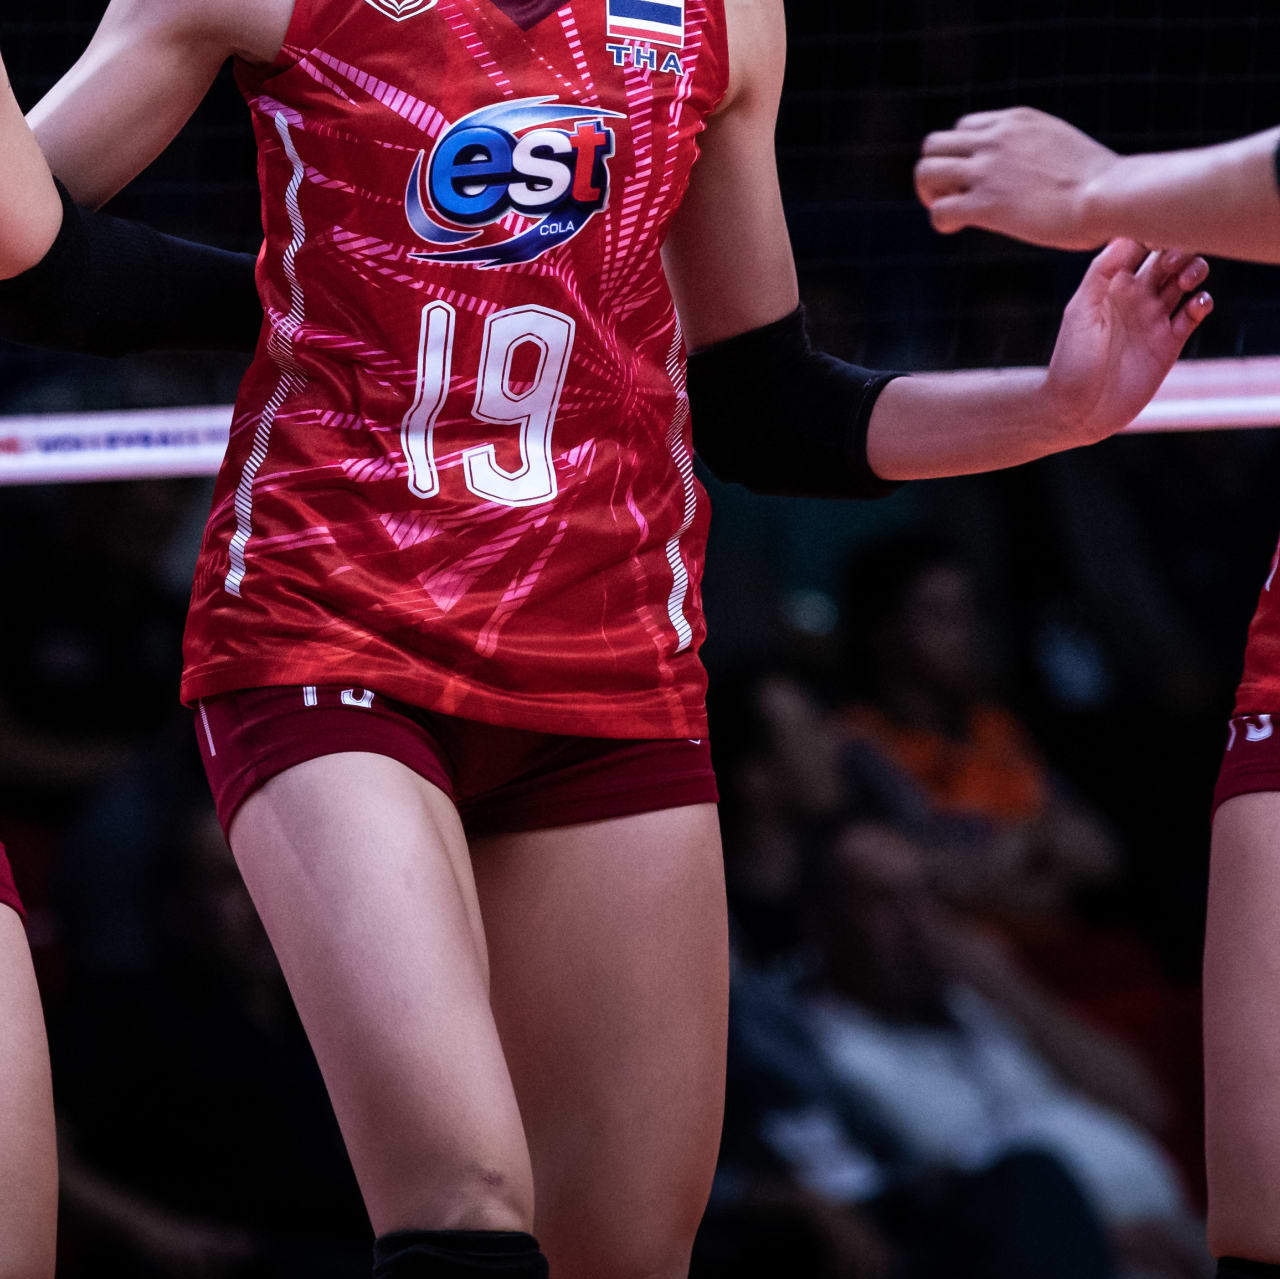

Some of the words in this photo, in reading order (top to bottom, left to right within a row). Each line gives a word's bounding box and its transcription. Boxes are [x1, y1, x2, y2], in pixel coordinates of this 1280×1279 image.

[605, 42, 685, 77] THA
[431, 122, 609, 217] est
[539, 221, 575, 236] COLA
[400, 299, 576, 508] 19
